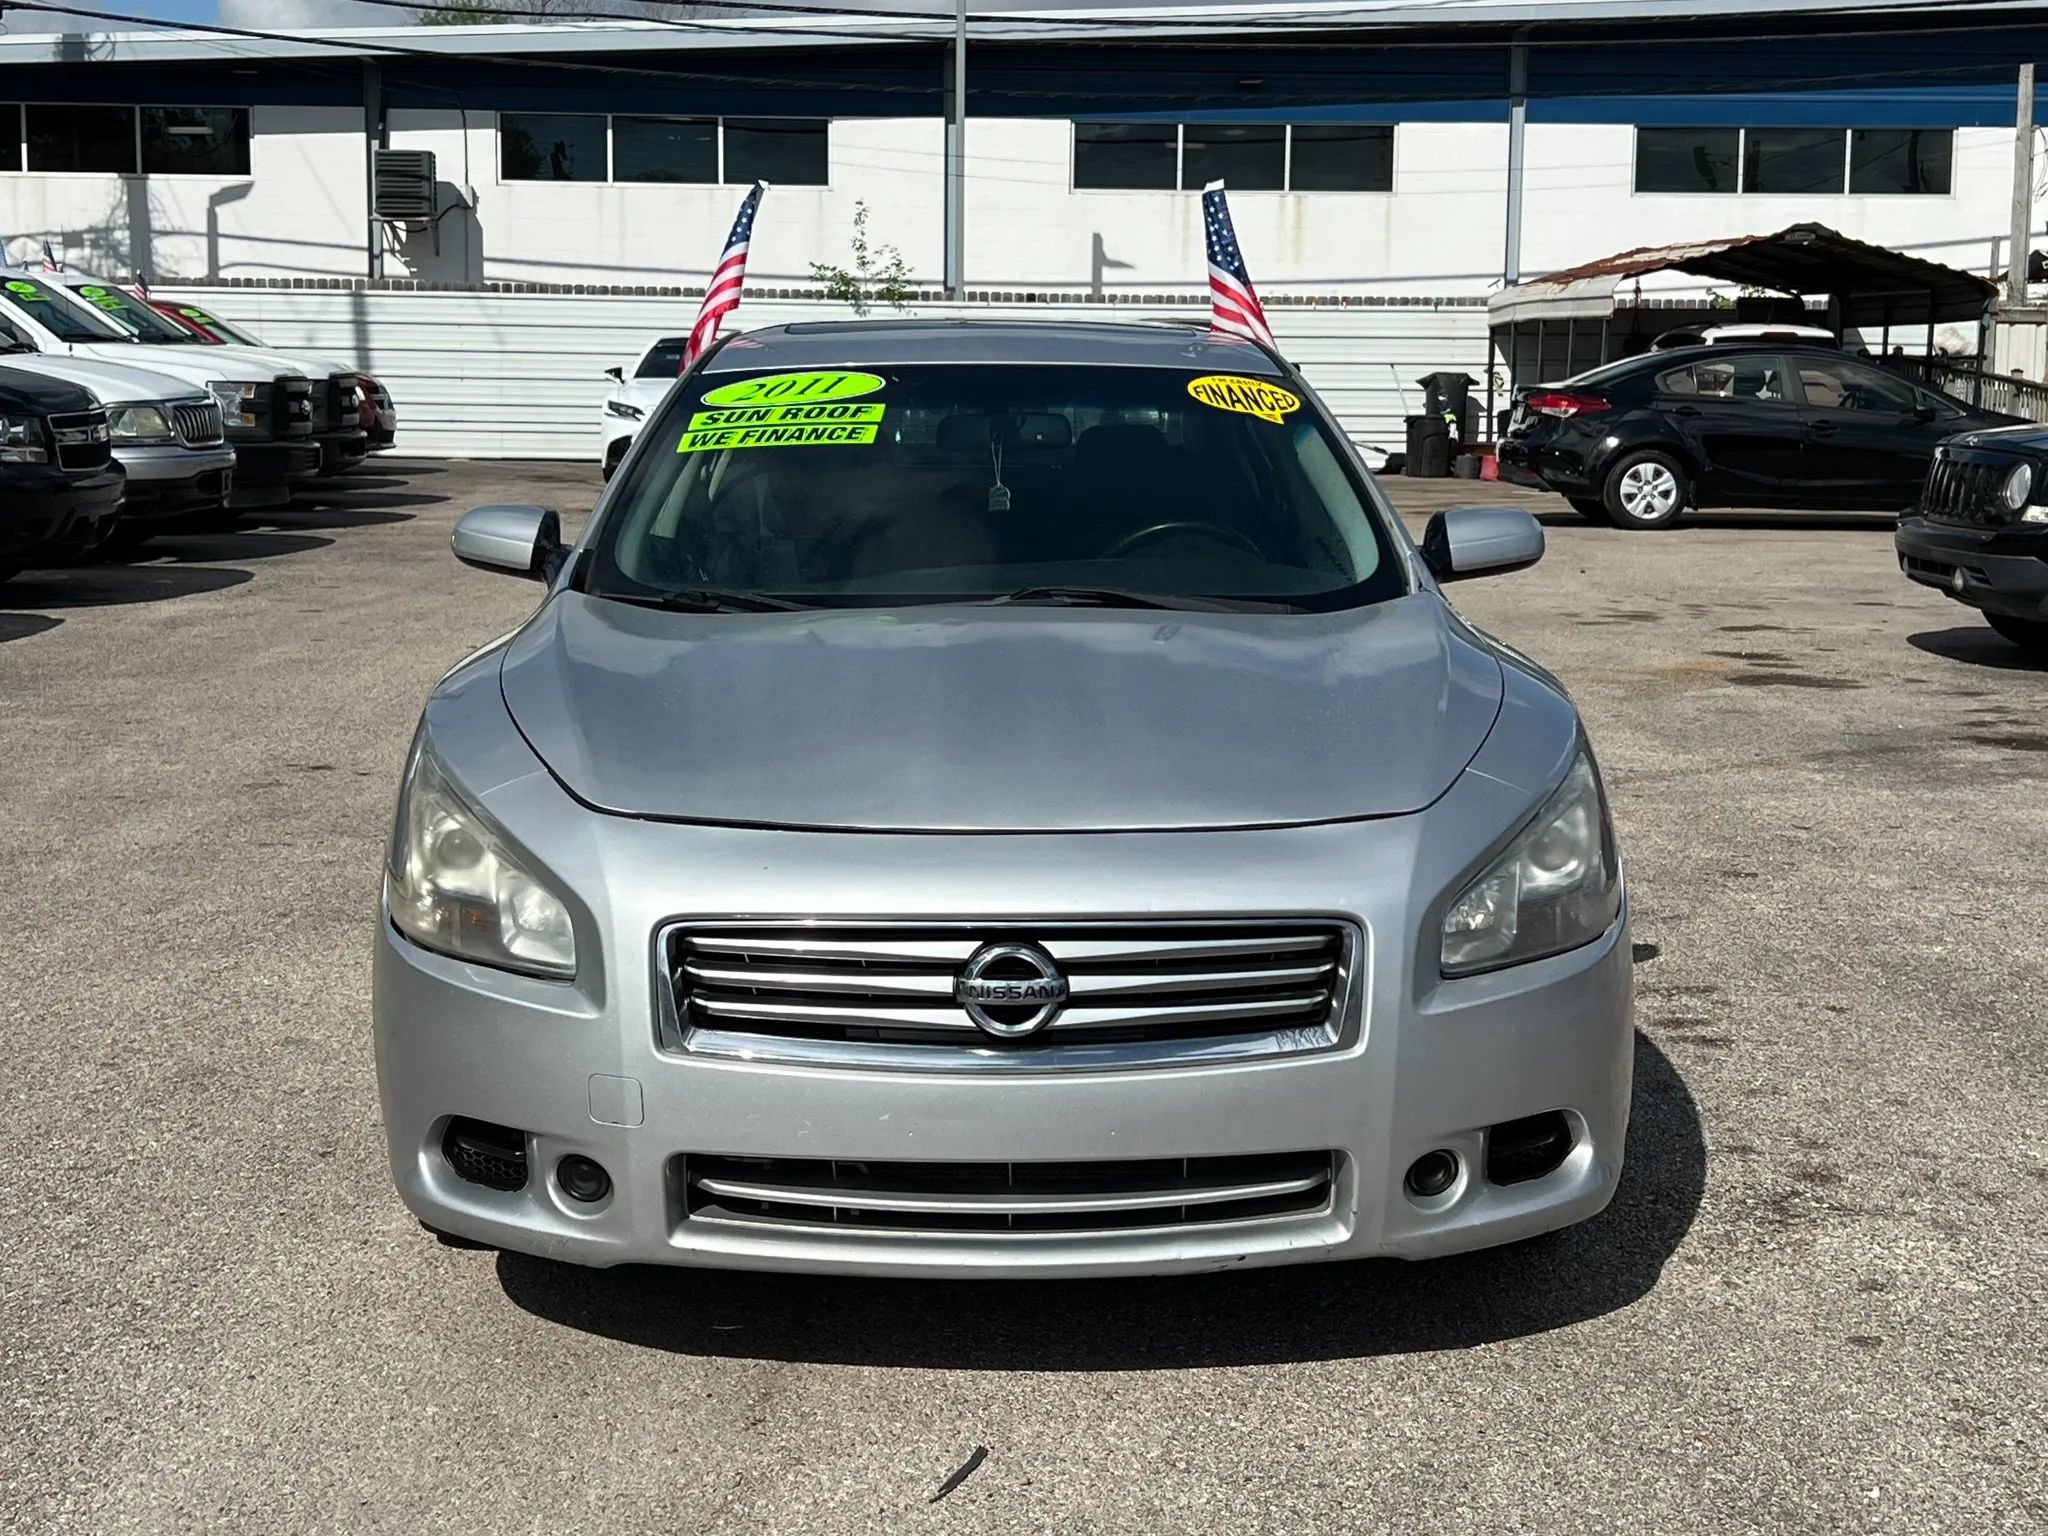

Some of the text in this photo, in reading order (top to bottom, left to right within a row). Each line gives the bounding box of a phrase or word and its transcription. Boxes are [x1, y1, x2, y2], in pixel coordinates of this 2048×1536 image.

[730, 376, 848, 403] 2011
[1193, 383, 1296, 412] FINANCED
[700, 405, 876, 426] SUN ROOF
[688, 427, 870, 448] WE FINANCE
[969, 986, 1054, 999] NISSAN
